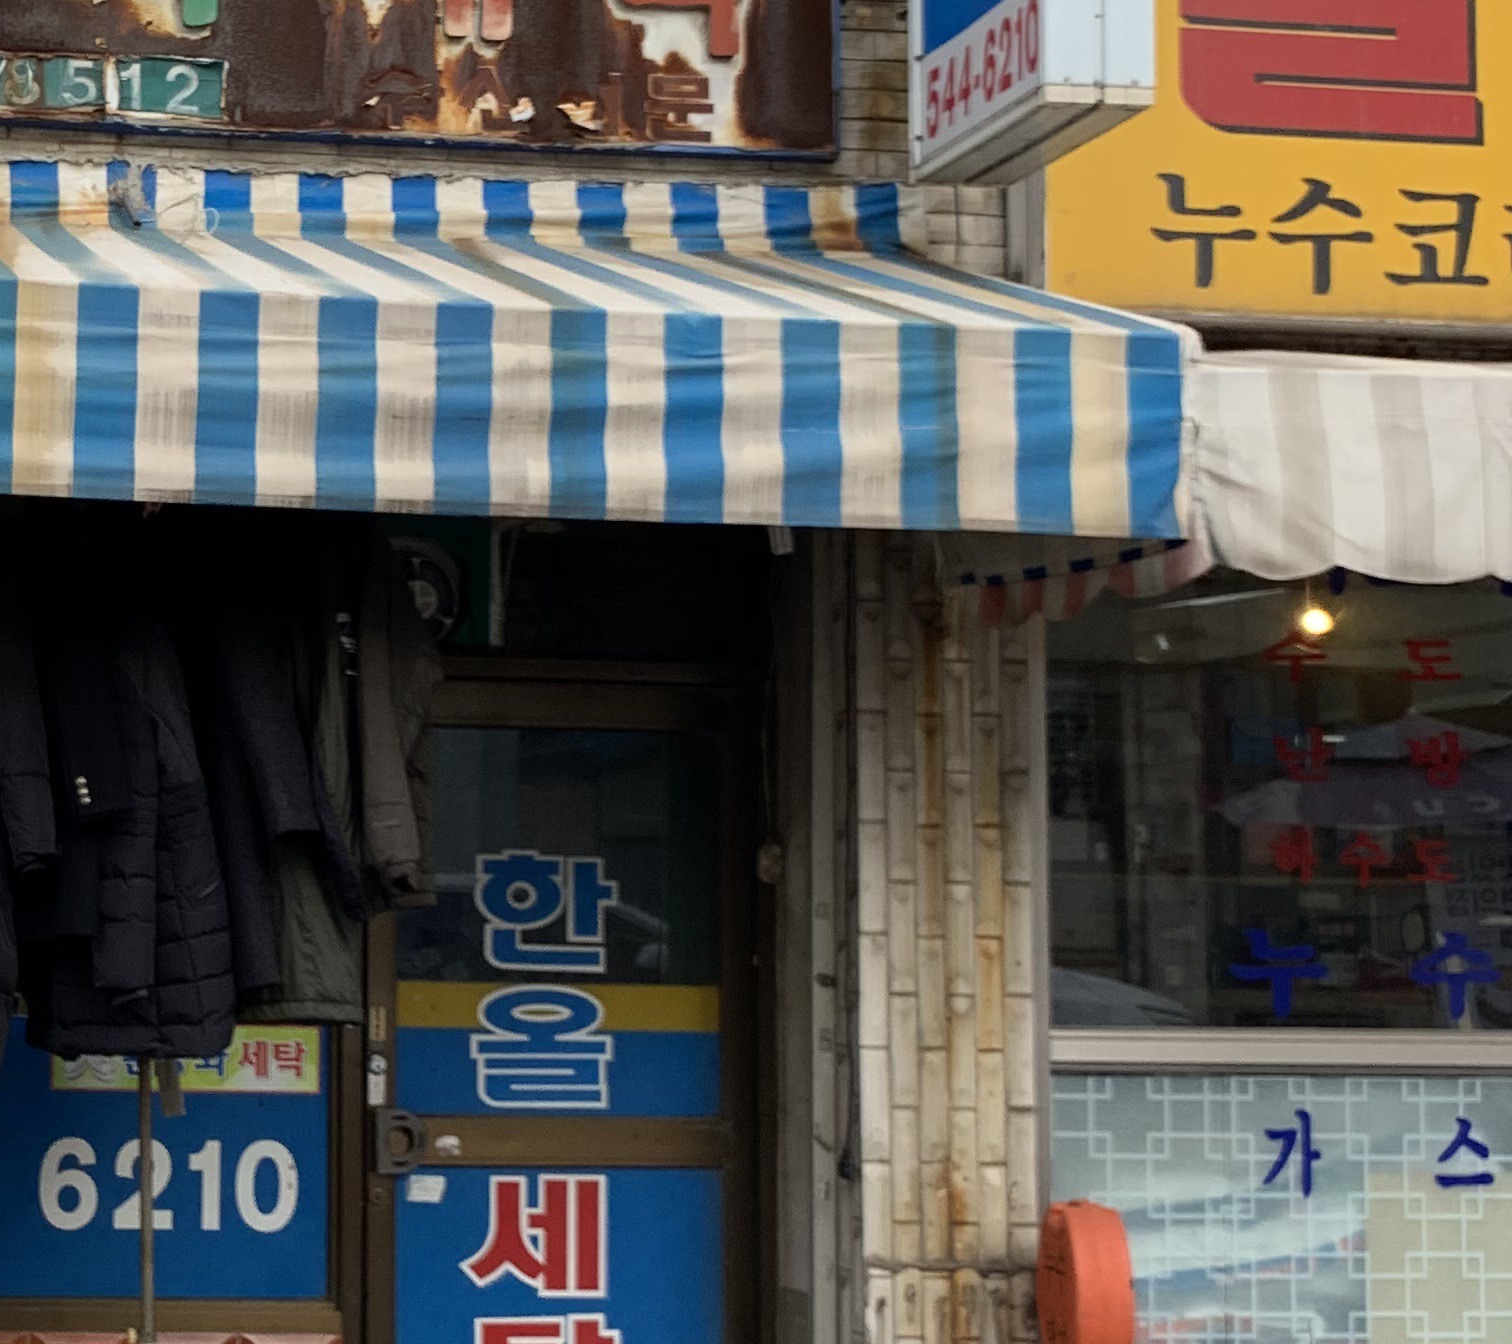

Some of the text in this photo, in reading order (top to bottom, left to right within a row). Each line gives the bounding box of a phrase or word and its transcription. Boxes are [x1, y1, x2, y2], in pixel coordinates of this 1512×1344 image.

[1150, 171, 1512, 295] 누수코
[239, 1040, 305, 1079] 세탁
[38, 1136, 299, 1234] 6210
